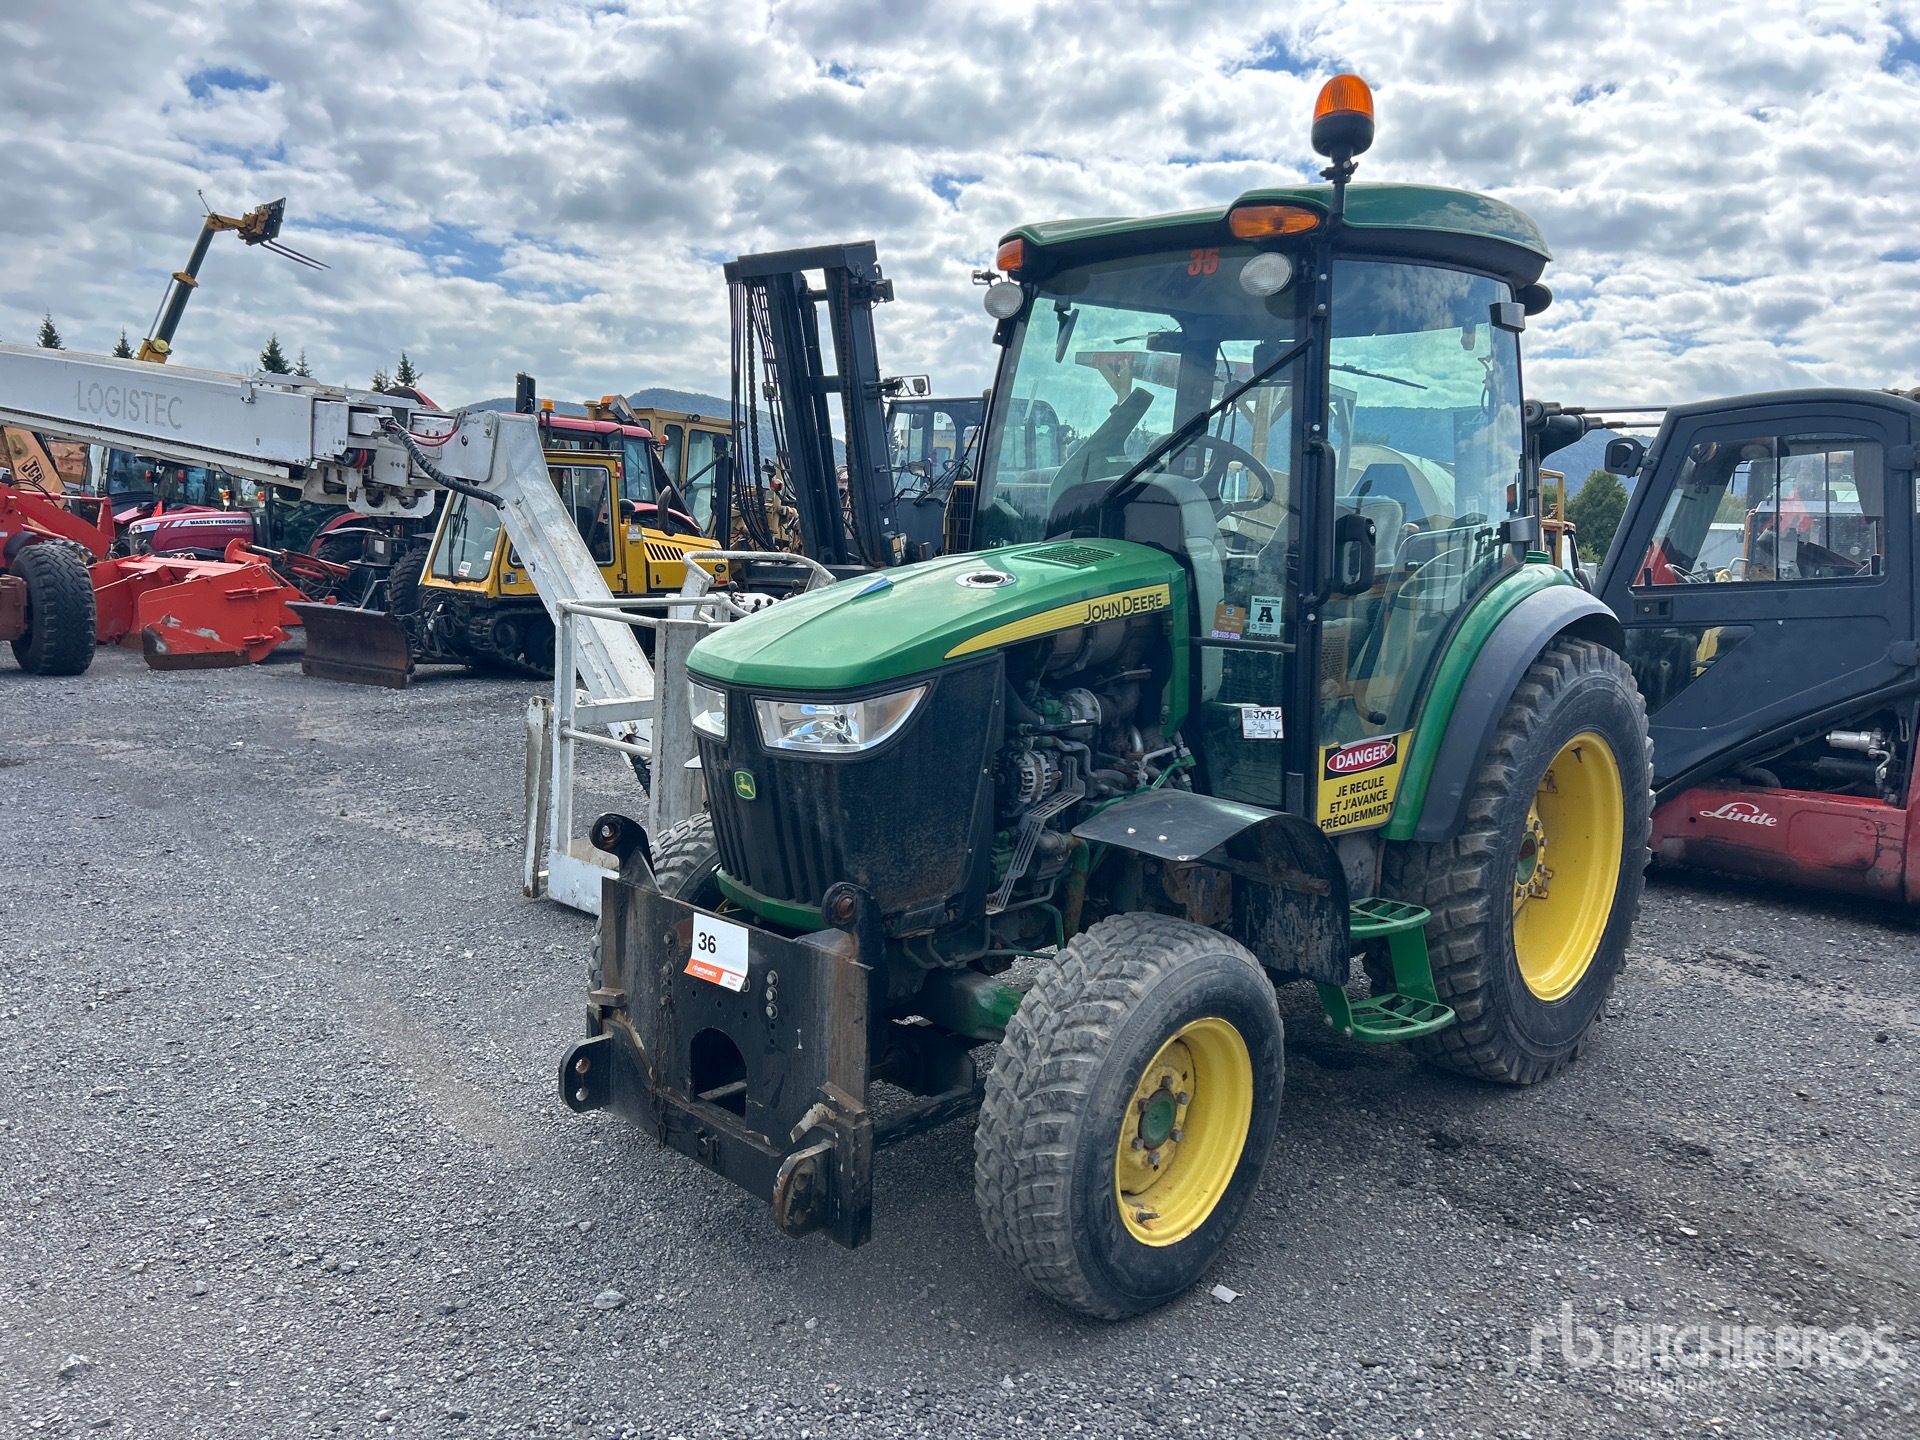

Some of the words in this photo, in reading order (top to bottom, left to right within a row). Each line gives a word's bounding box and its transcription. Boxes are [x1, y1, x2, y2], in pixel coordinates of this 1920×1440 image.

[1187, 247, 1219, 275] 35
[77, 380, 183, 430] LOGISTEC
[21, 460, 43, 483] JCB
[1083, 603, 1121, 622] JOHN
[1122, 593, 1163, 613] DEERE
[1257, 606, 1274, 622] A
[1335, 744, 1388, 770] DANGER
[1336, 785, 1348, 798] JE
[1349, 776, 1385, 795] RECULE
[1329, 801, 1342, 814] ET
[1343, 789, 1388, 811] J'AVANCE
[1319, 802, 1394, 830] FRÉQUEMMENT
[1699, 802, 1777, 827] Linde
[698, 932, 716, 954] 36
